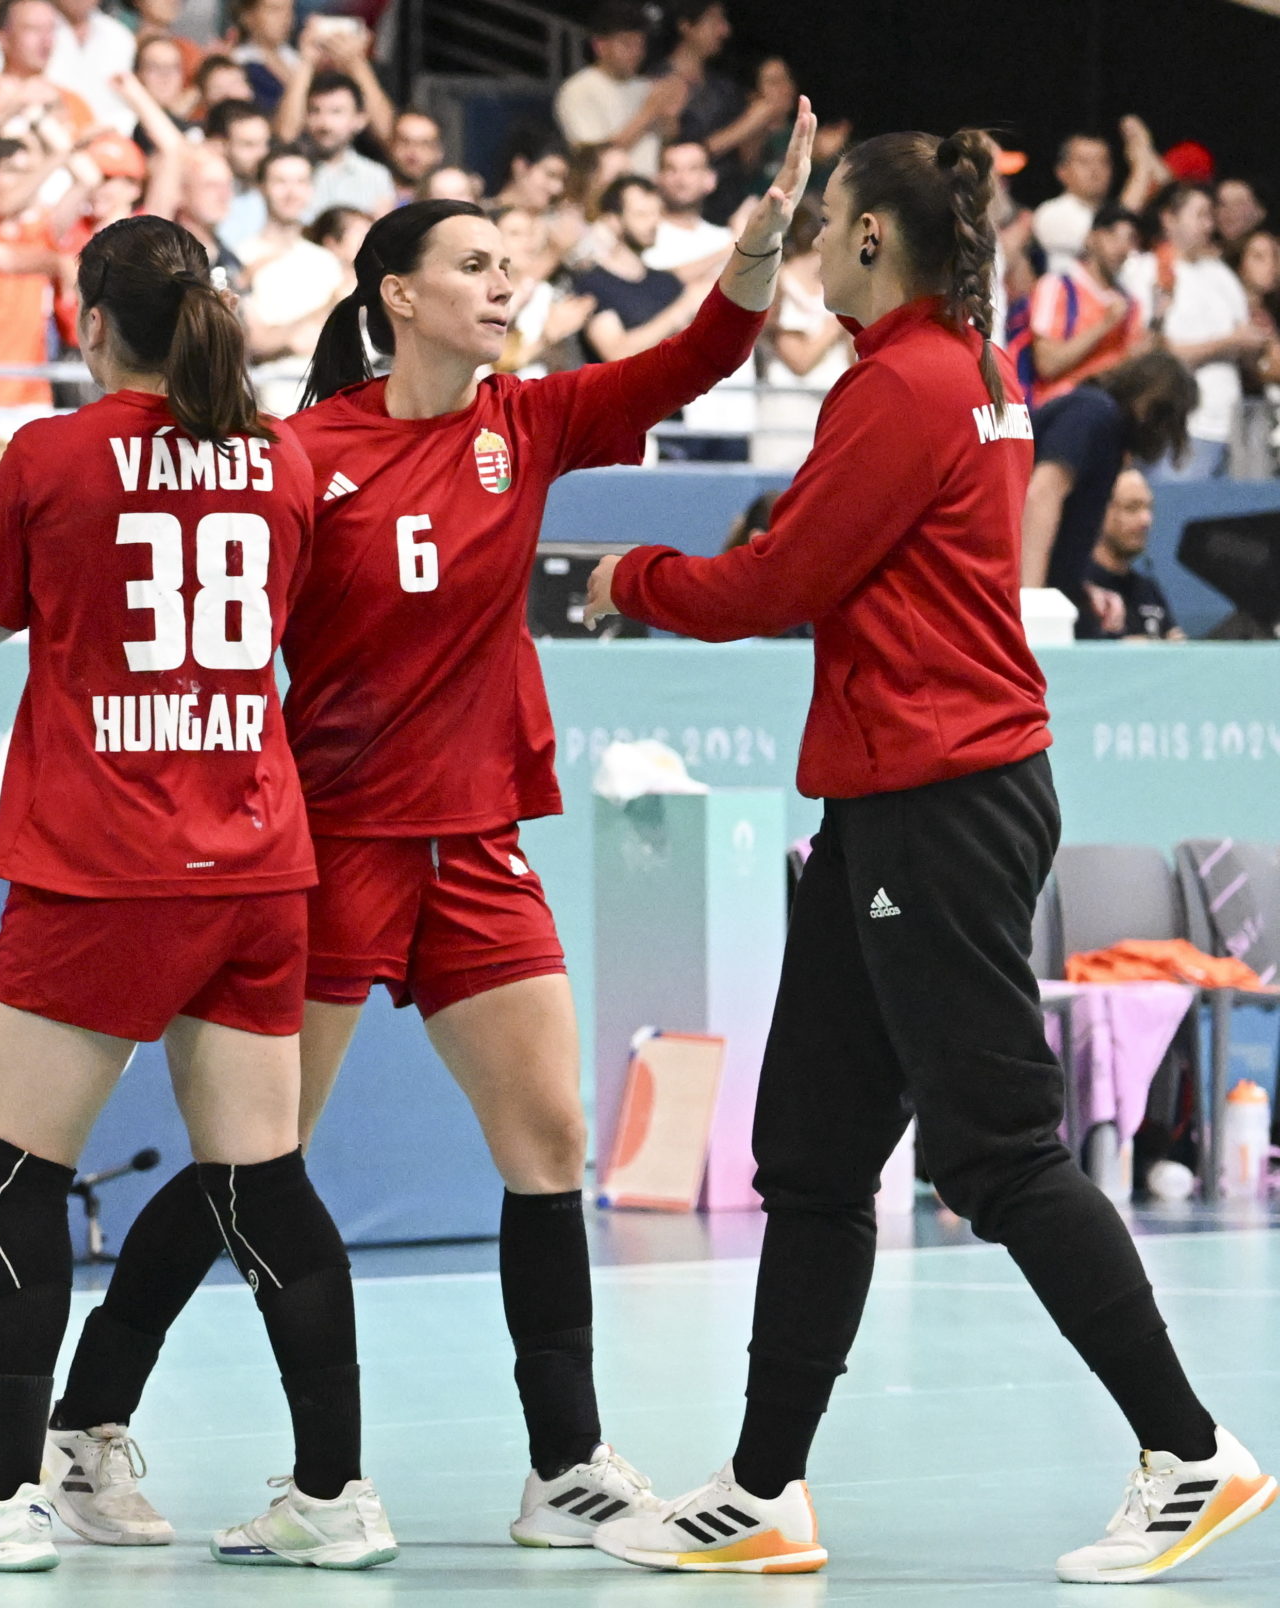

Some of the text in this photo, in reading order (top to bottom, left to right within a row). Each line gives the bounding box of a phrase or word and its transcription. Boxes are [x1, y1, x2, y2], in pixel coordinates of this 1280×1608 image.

[109, 426, 273, 492] VÁMOS
[396, 513, 439, 593] 6
[115, 512, 272, 672] 38
[92, 694, 267, 752] HUNGAR
